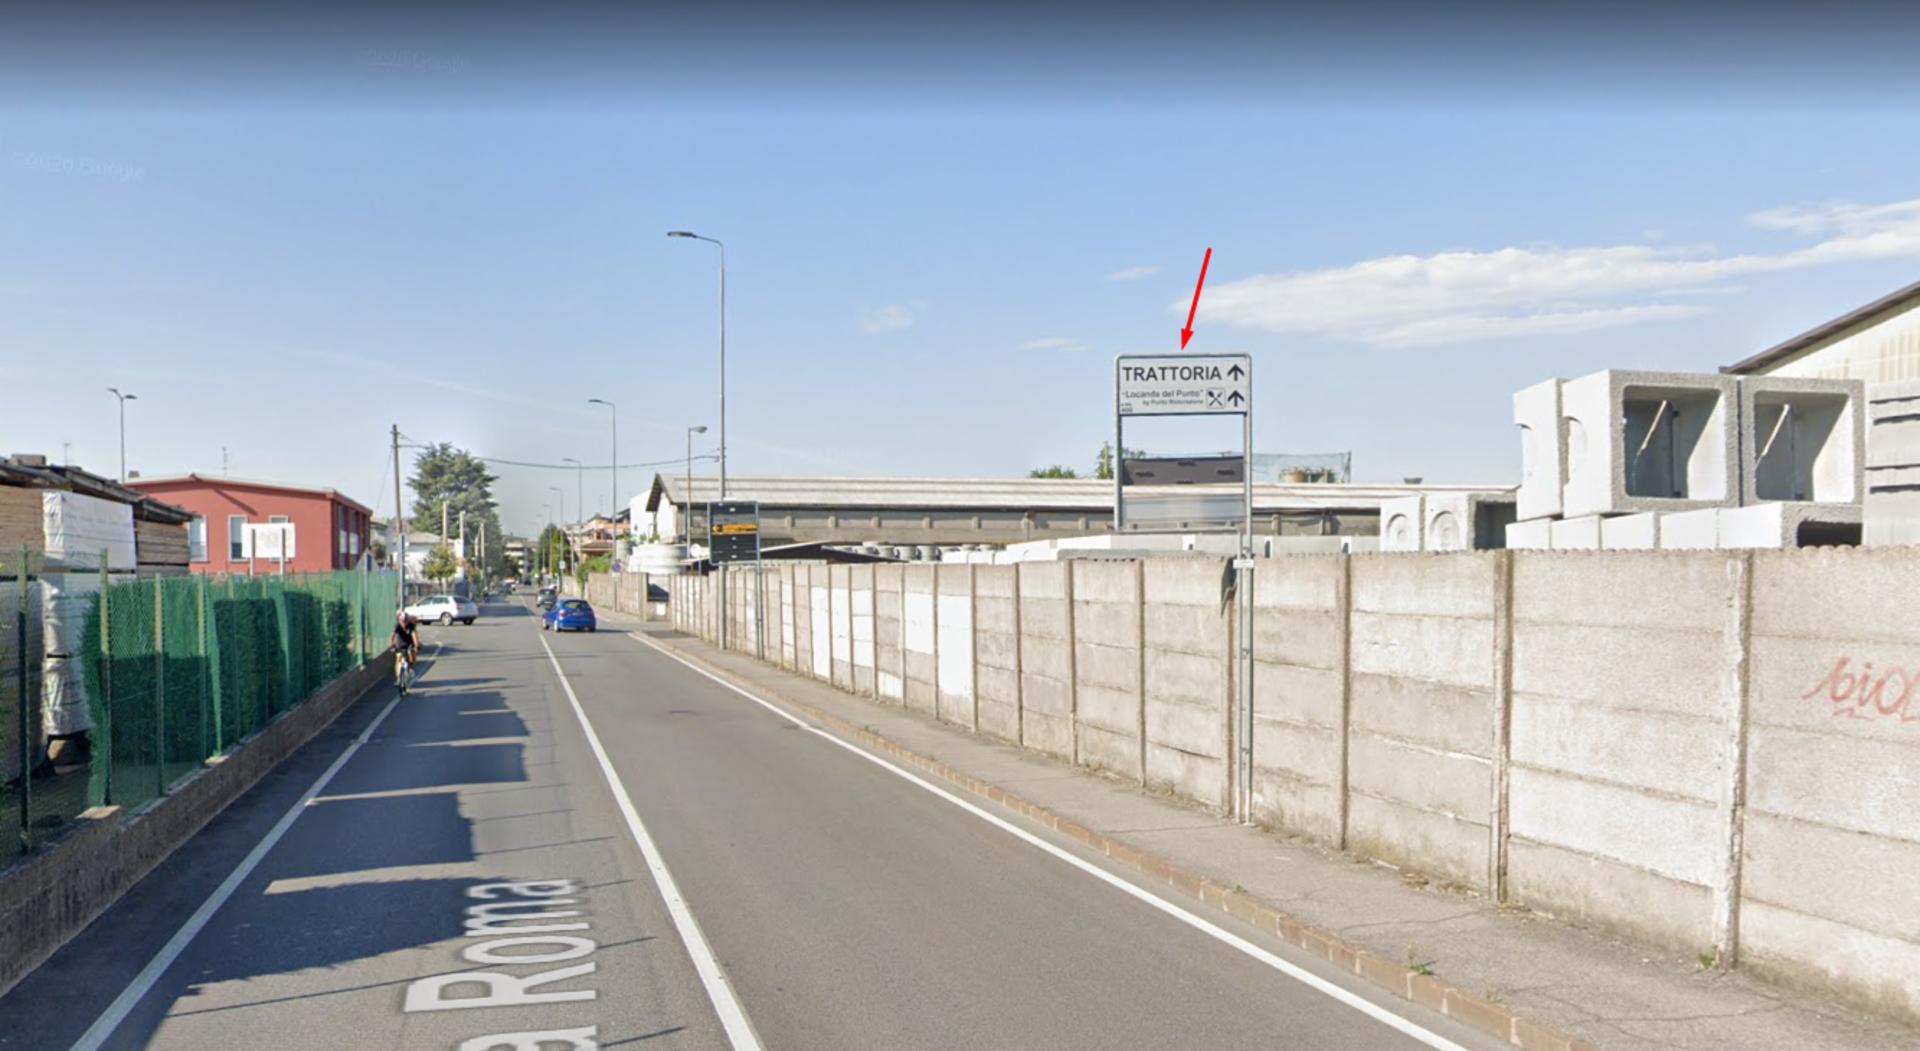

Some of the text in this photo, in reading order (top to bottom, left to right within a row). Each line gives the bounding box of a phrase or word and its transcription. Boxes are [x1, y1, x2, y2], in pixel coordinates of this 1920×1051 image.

[1122, 366, 1222, 381] TRATTORIA
[1162, 389, 1174, 397] del
[403, 879, 596, 1012] Roma
